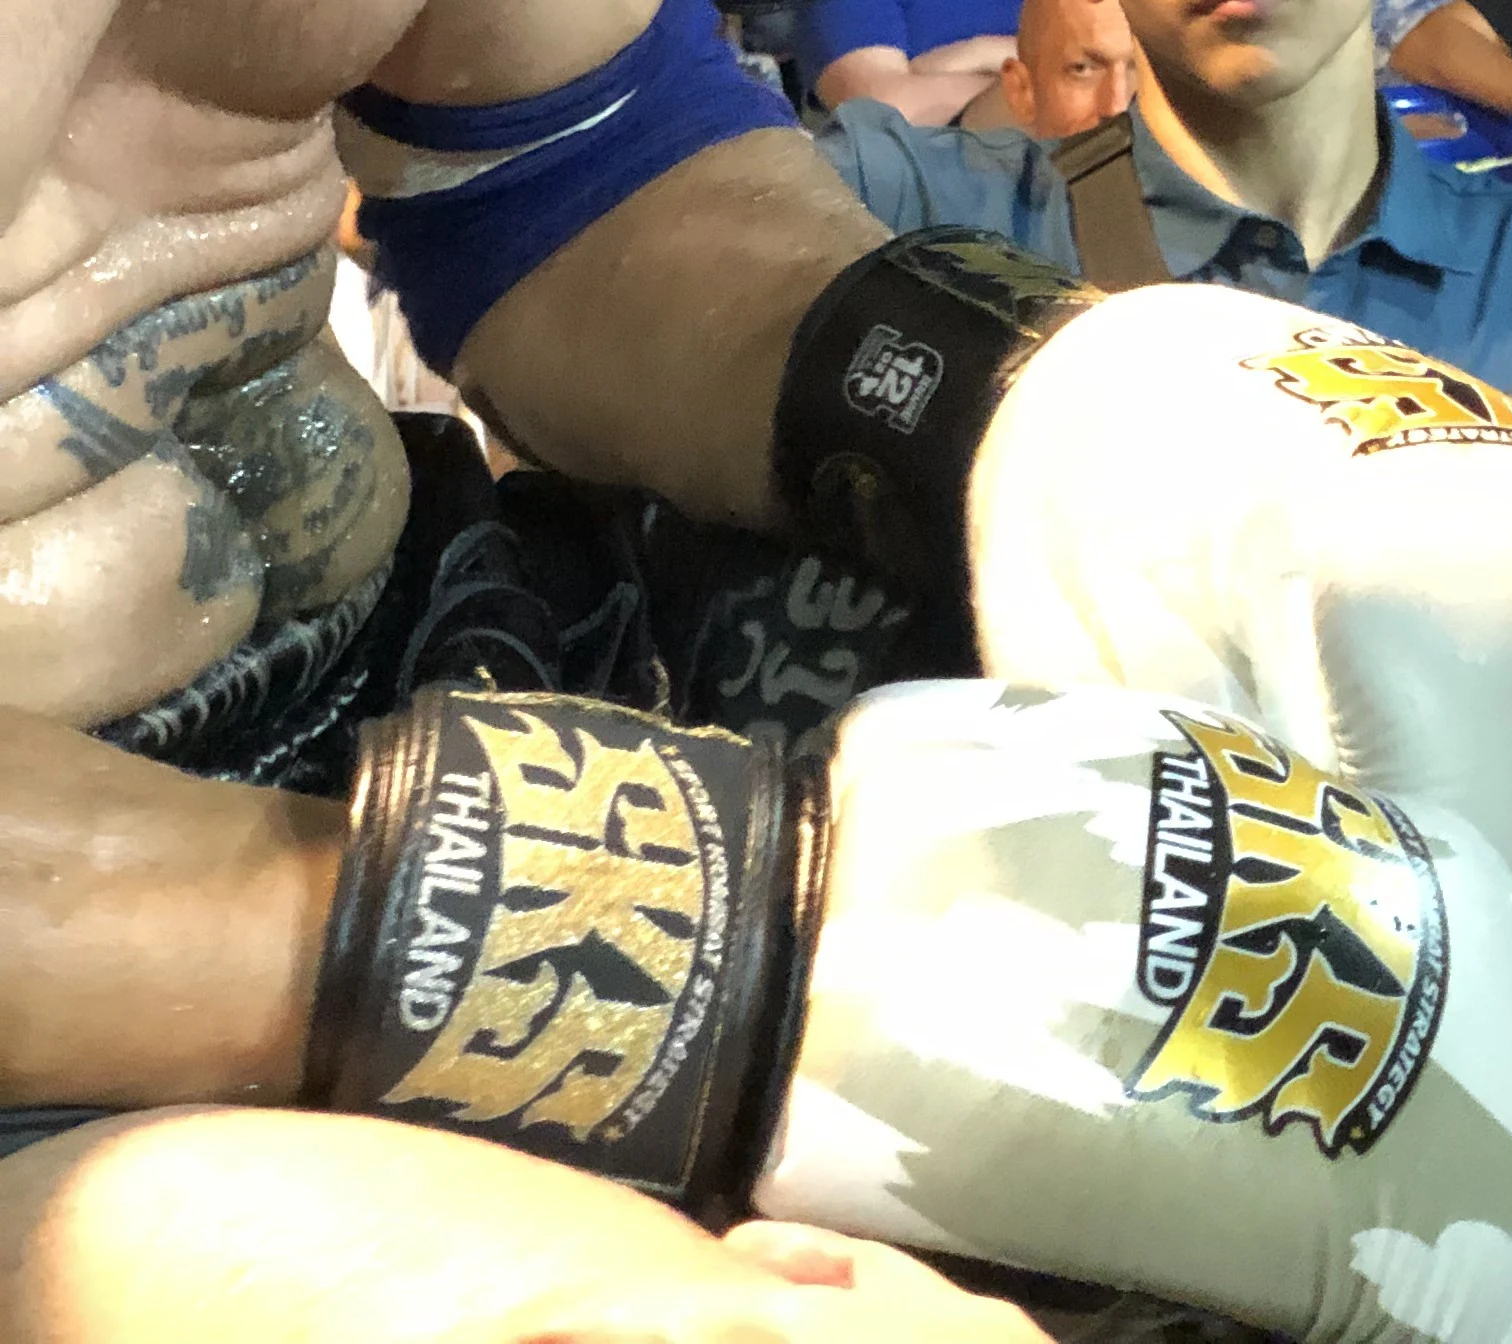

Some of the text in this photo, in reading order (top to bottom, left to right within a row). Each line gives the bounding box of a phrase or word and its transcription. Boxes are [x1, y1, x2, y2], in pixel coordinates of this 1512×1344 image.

[874, 355, 924, 404] 12
[400, 770, 494, 1032] THAILAND
[1146, 756, 1214, 1002] THAILAND
